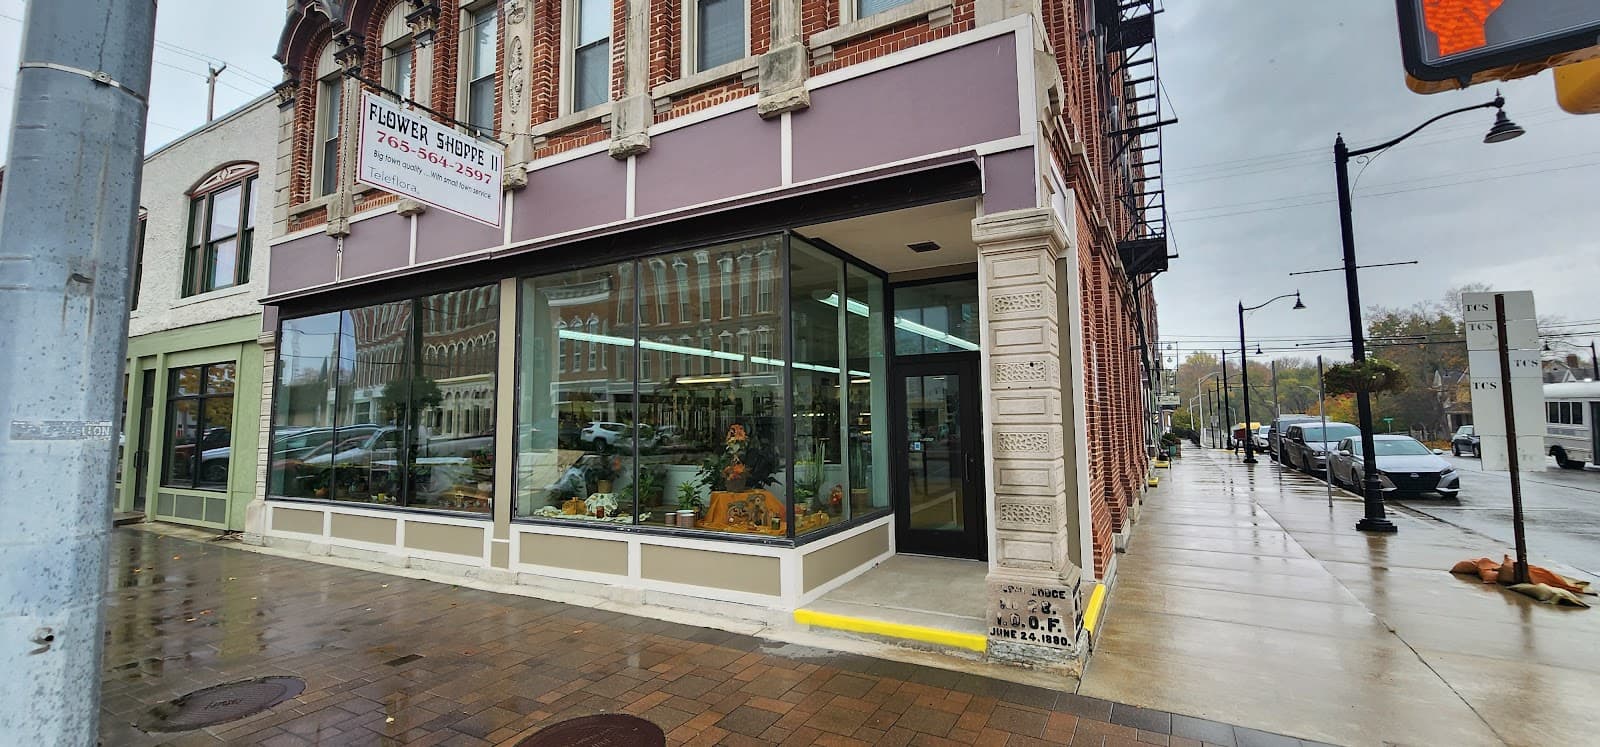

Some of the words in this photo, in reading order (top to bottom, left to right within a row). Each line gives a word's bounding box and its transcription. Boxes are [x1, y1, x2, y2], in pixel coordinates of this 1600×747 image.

[369, 102, 428, 145] FLOWER
[437, 131, 484, 166] SHOPPE
[376, 130, 492, 184] 765-564-2597
[373, 149, 384, 162] Big
[385, 155, 401, 167] town
[402, 162, 423, 176] quality
[443, 177, 459, 187] small
[458, 182, 472, 192] town
[1465, 304, 1489, 312] TCS
[1469, 323, 1493, 331] TCS
[1514, 359, 1538, 367] TCS
[1473, 382, 1497, 390] TCS
[990, 627, 1017, 639] JUNE
